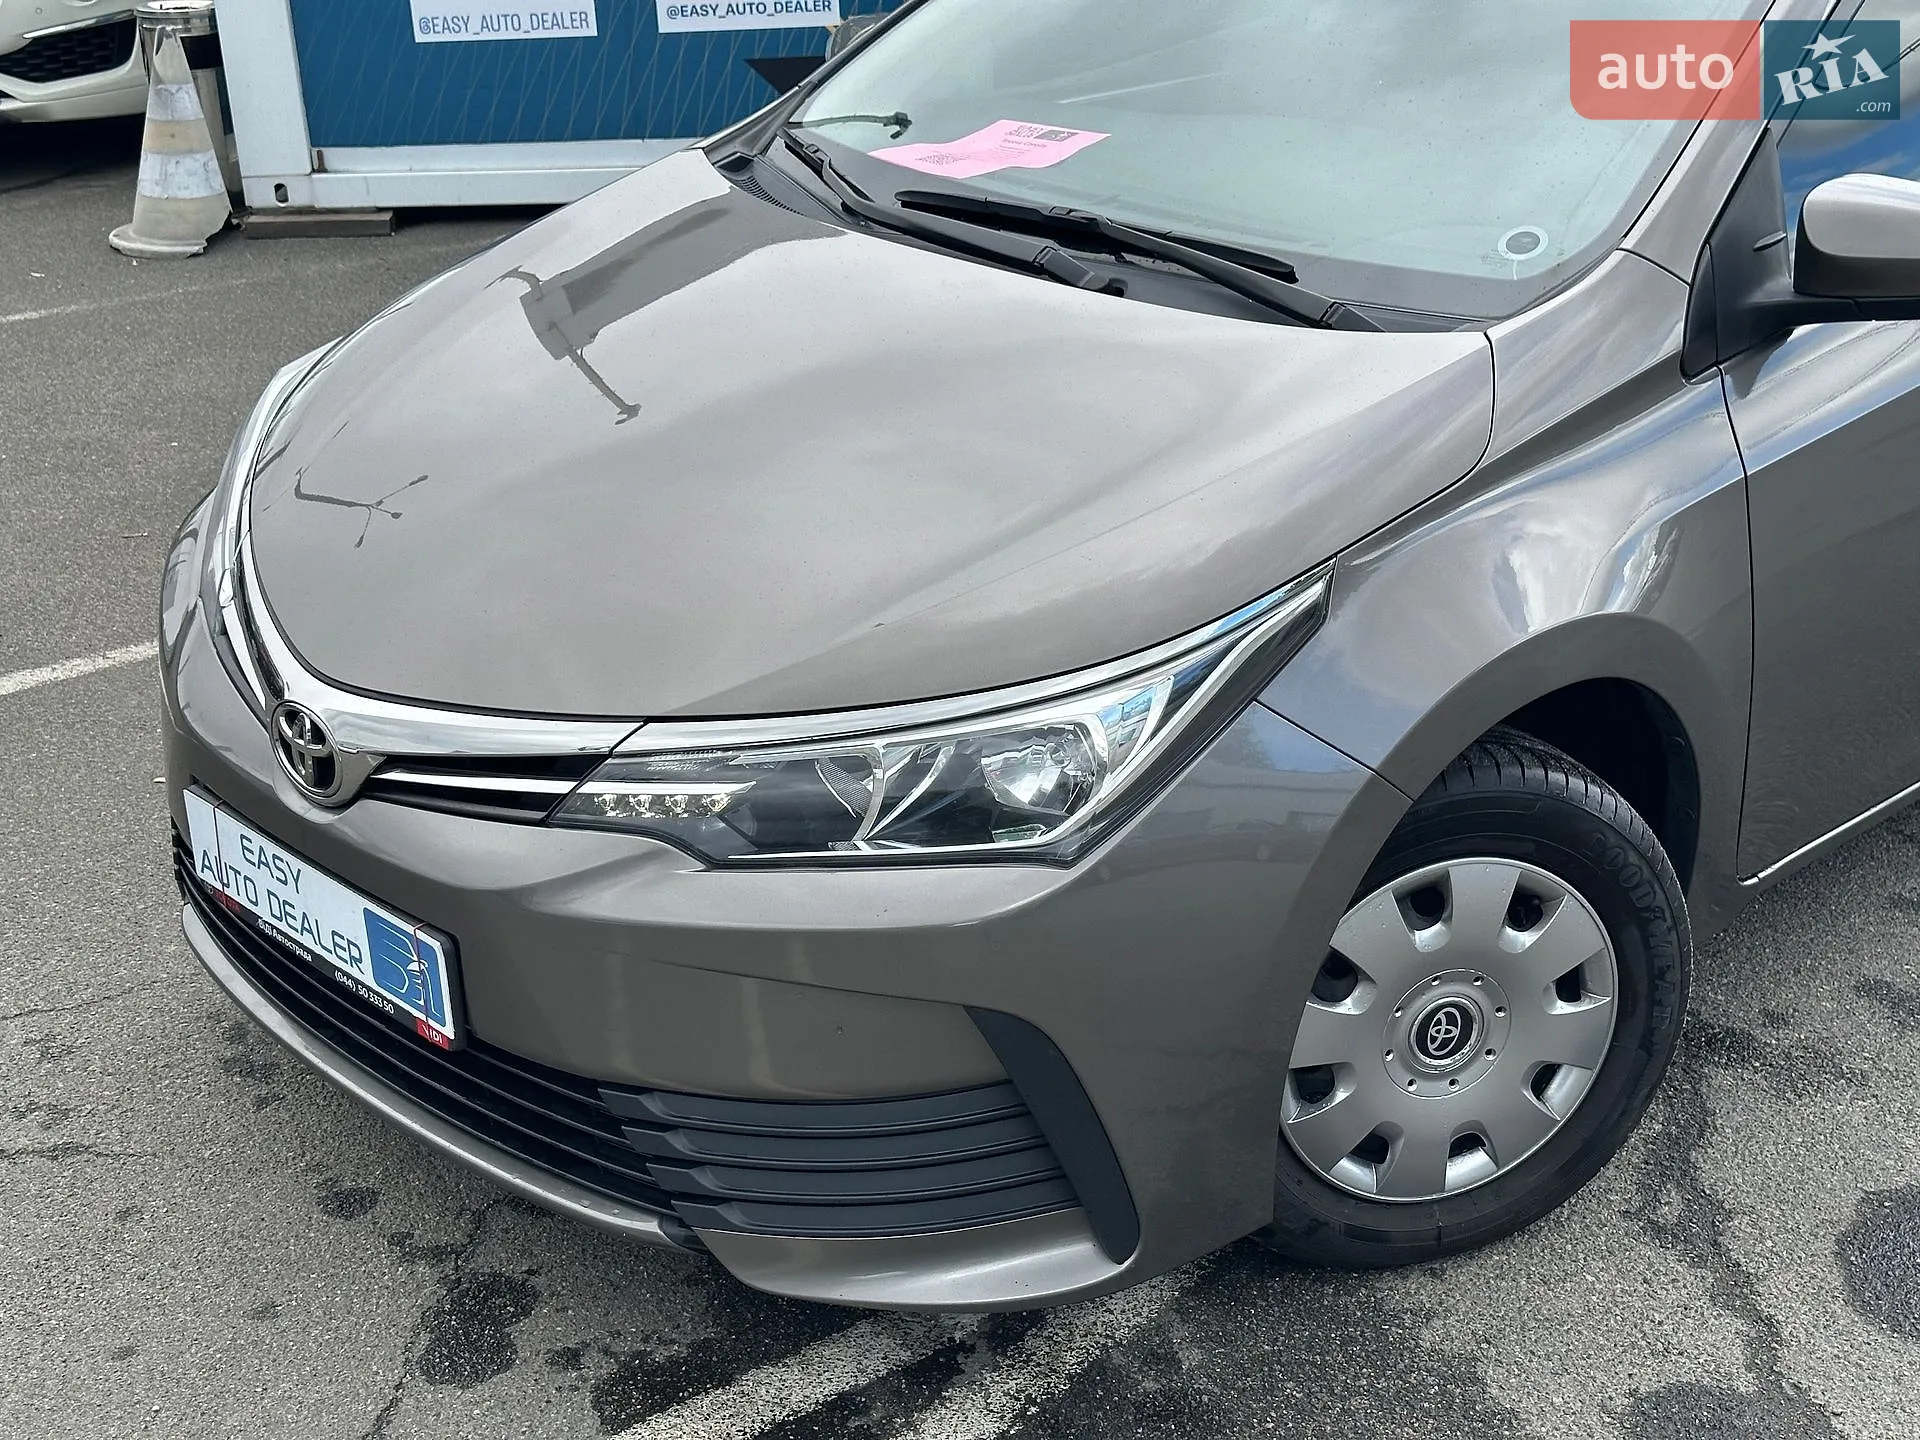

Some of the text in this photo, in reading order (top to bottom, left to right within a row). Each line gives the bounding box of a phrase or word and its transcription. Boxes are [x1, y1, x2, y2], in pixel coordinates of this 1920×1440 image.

[419, 11, 590, 35] @EASY_AUTO_DEALER
[667, 0, 832, 19] @EASY_AUTO_DEALER
[239, 833, 302, 894] EASY
[200, 849, 365, 975] AUTO DEALER
[334, 969, 395, 1014] (044) 50 333 50
